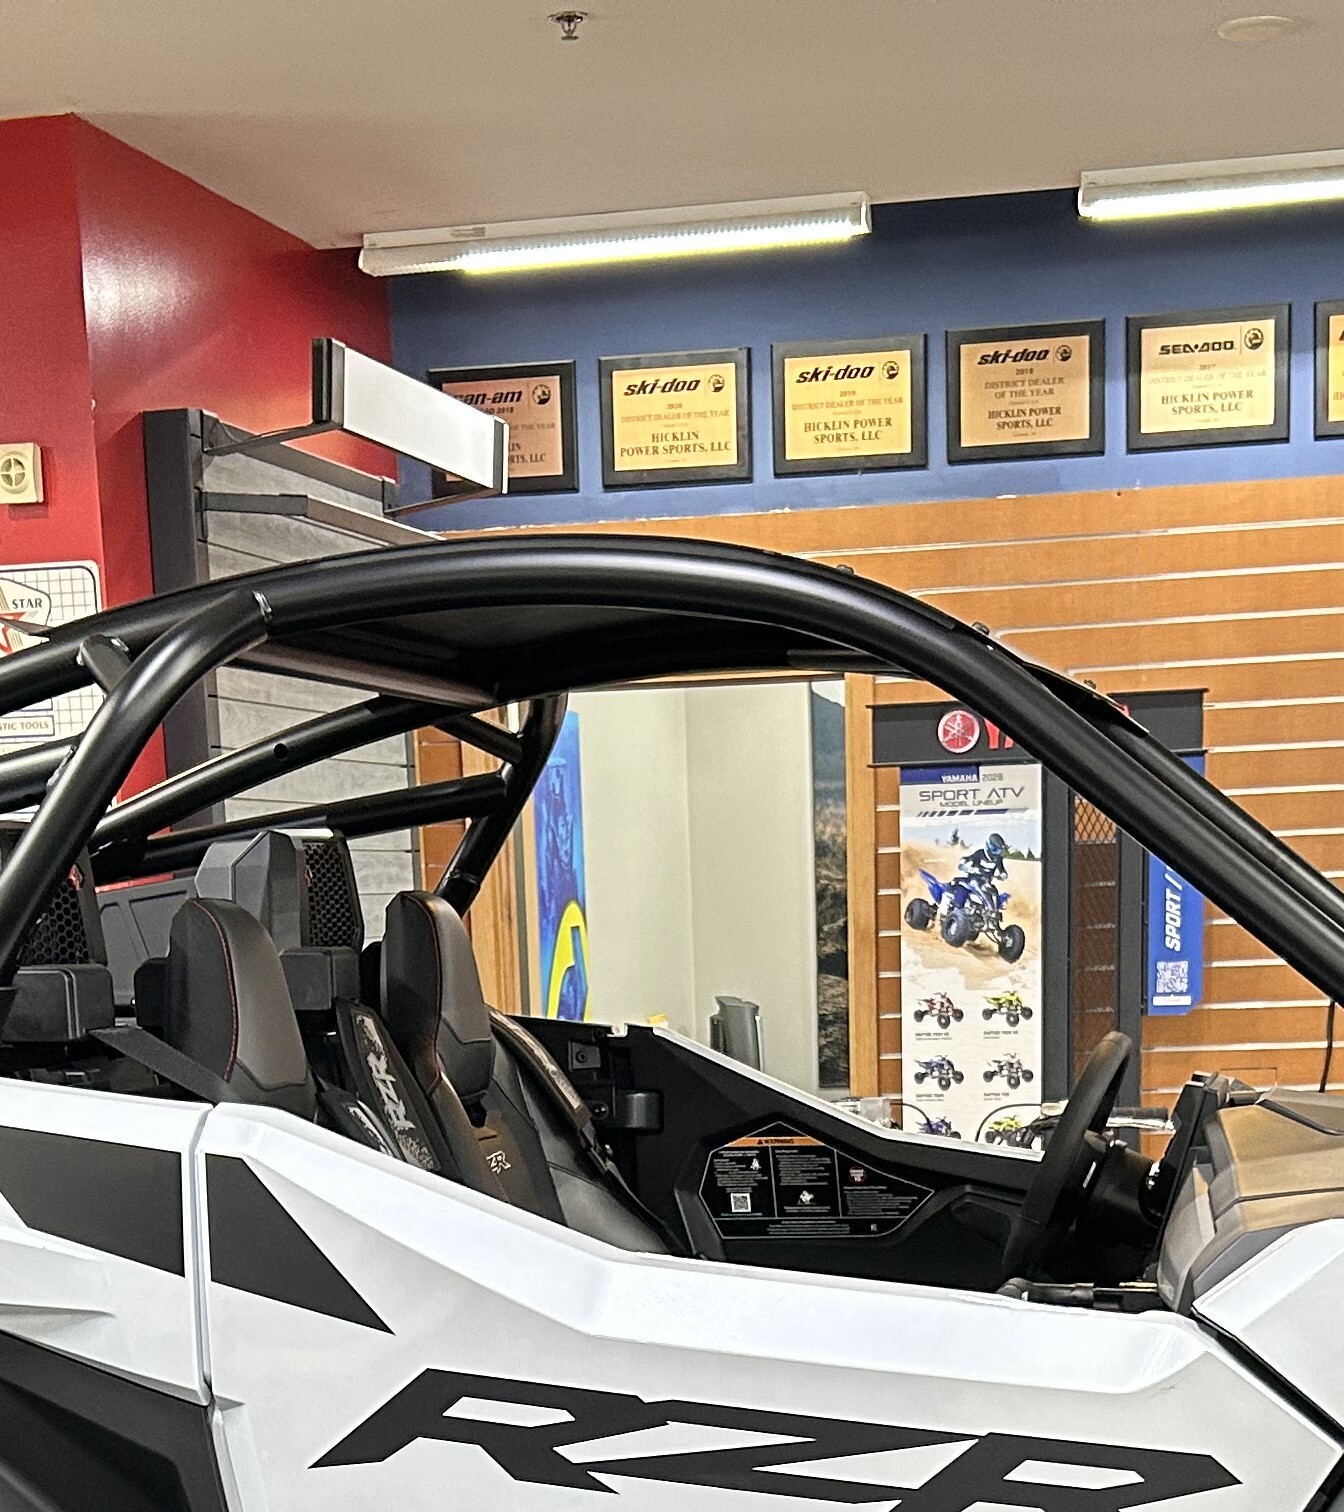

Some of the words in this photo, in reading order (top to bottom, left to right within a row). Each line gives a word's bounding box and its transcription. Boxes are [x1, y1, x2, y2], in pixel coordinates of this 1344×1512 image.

[977, 348, 1050, 365] ski-doo
[796, 365, 875, 383] ski-doo
[623, 378, 701, 396] ski-doo
[1028, 377, 1064, 387] DEALER
[994, 390, 1006, 399] OF
[1009, 389, 1028, 398] THE
[1030, 388, 1055, 397] YEAR
[1161, 393, 1209, 405] HICKLIN
[1213, 390, 1253, 401] POWER
[988, 408, 1026, 419] HICKLIN
[1029, 406, 1062, 417] POWER
[1172, 403, 1218, 415] SPORTS,
[1221, 402, 1243, 412] LLC
[804, 420, 850, 432] HICKLIN
[853, 417, 892, 429] POWER
[996, 420, 1033, 430] SPORTS,
[1036, 418, 1054, 428] LLC
[651, 430, 699, 443] HICKLIN
[861, 429, 882, 440] LLC
[620, 446, 659, 457] POWER
[662, 443, 708, 454] SPORTS,
[710, 441, 732, 452] LLC
[530, 453, 547, 463] LLC
[13, 598, 42, 609] STAR
[20, 721, 49, 730] TOOLS
[941, 774, 978, 783] YAMAHA
[919, 788, 981, 802] SPORT
[987, 786, 1024, 799] ATV
[1165, 888, 1182, 952] SPORT
[367, 1052, 416, 1131] RZR
